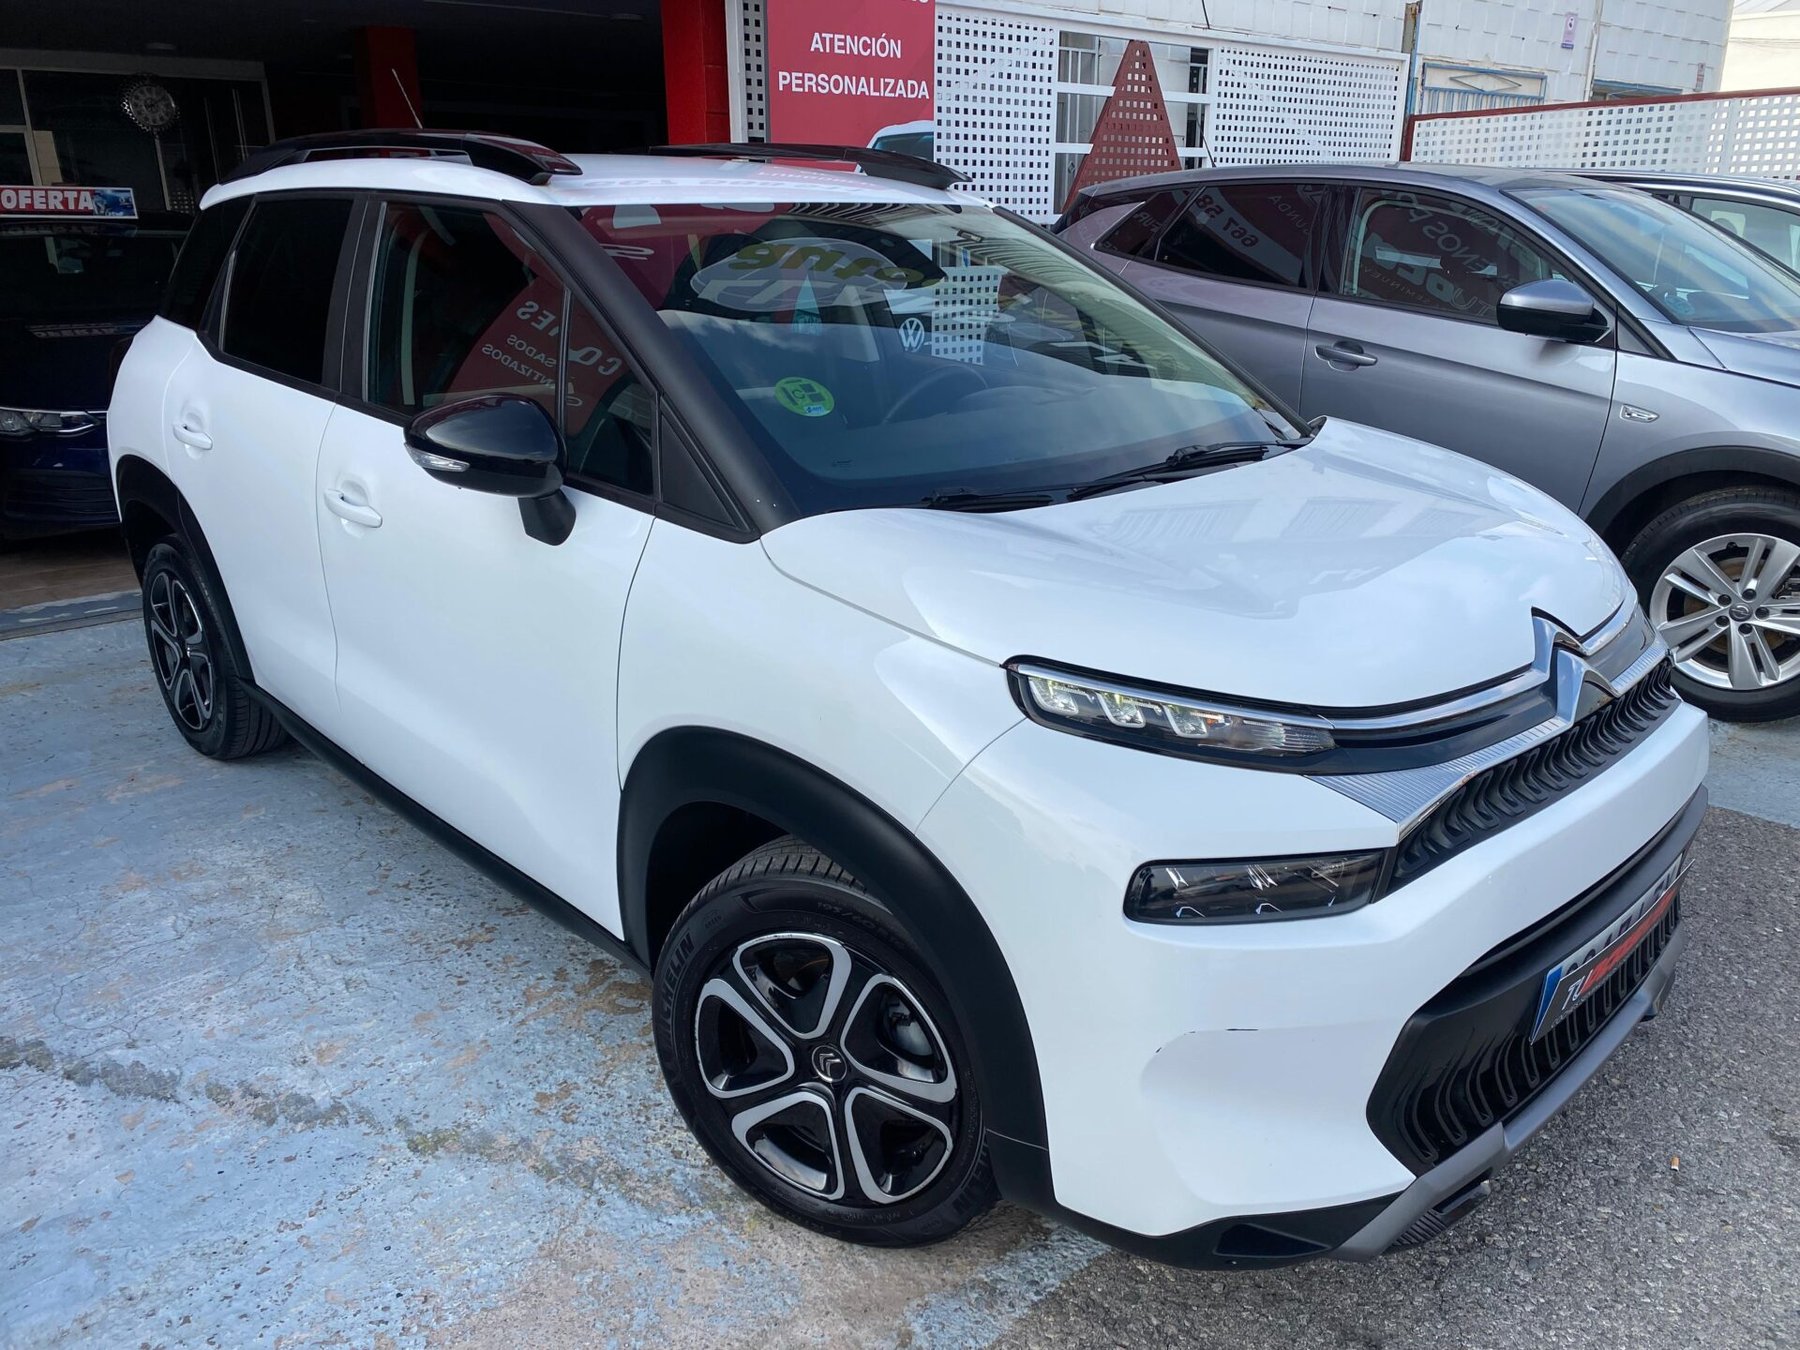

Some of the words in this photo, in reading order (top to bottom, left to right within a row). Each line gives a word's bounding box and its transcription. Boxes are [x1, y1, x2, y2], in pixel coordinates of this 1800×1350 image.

[810, 32, 902, 59] ATENCIÓN
[778, 71, 930, 100] PERSONALIZADA
[0, 189, 94, 210] OFERTA
